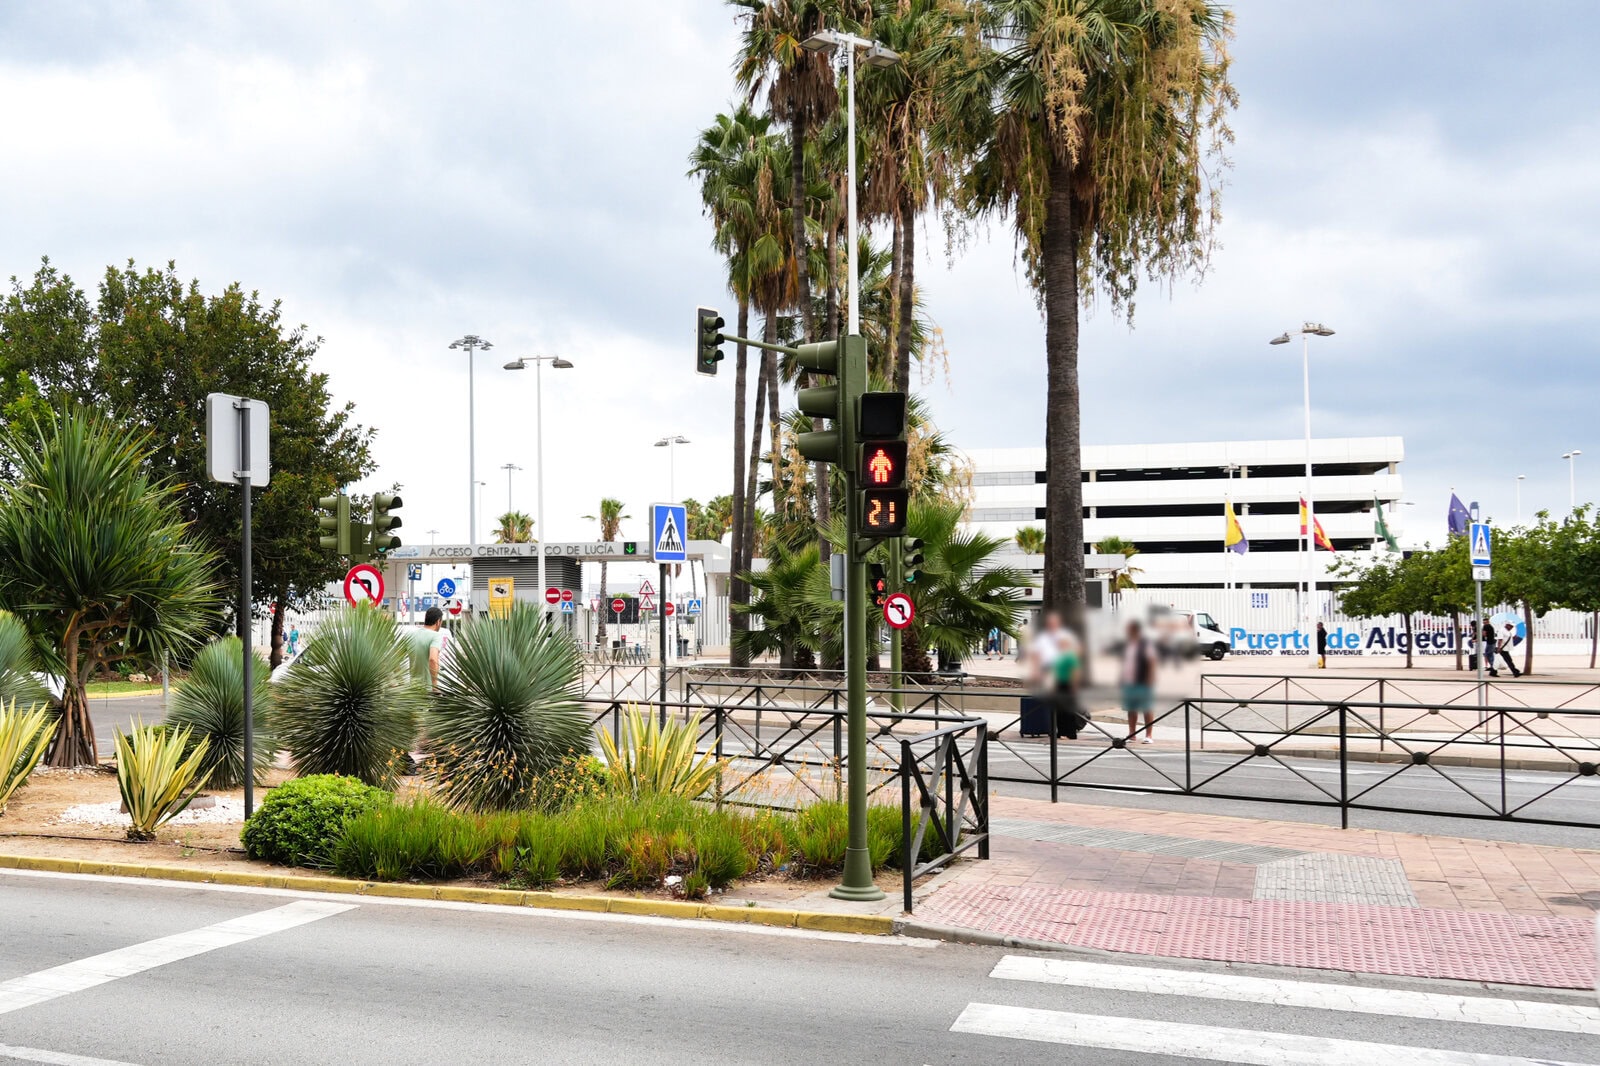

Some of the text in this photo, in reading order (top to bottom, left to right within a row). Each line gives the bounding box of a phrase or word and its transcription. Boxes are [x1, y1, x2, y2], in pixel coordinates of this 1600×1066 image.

[868, 499, 896, 526] 21
[429, 547, 472, 557] ACCESO
[477, 546, 522, 557] CENTRAL
[530, 545, 562, 555] PCO
[566, 545, 580, 555] DE
[584, 543, 614, 555] LUCÍA
[1327, 627, 1360, 649] de
[1365, 627, 1474, 654] Algeci
